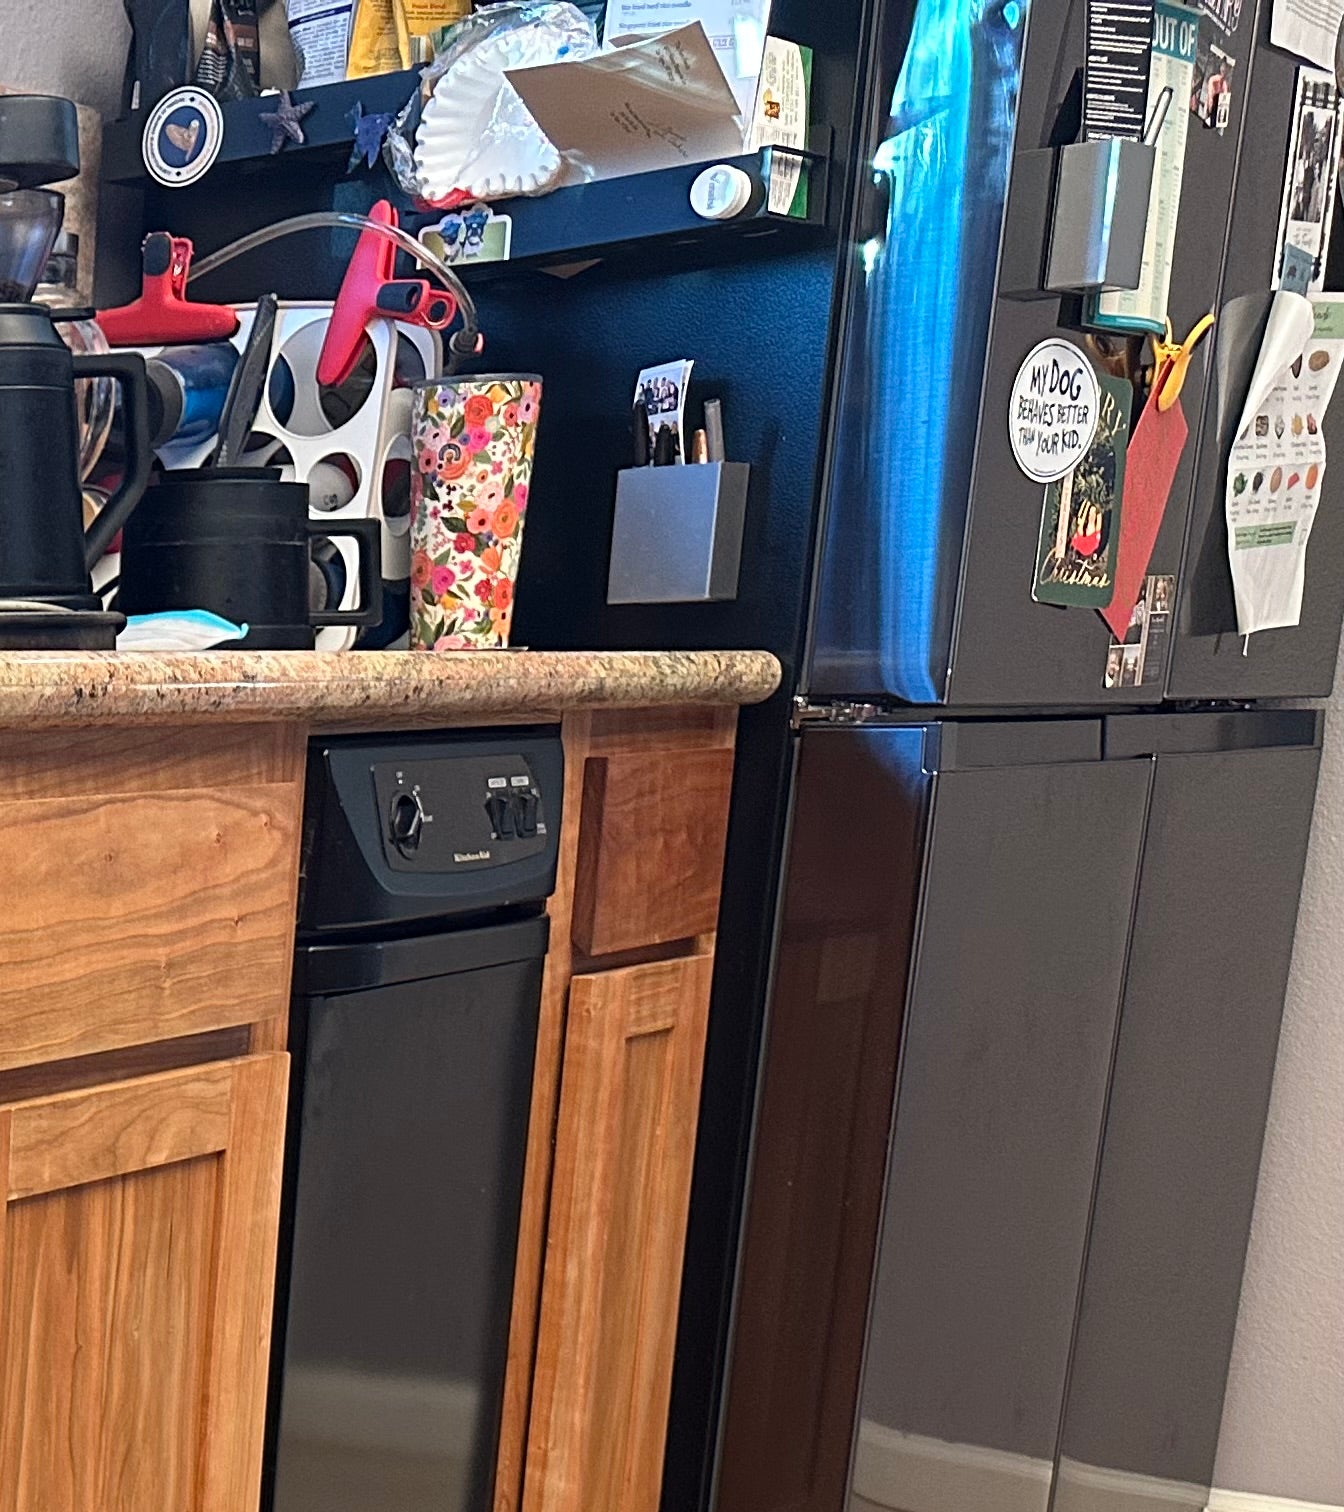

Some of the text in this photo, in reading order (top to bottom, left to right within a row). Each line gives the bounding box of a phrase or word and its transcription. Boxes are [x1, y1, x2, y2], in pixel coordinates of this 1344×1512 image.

[1180, 21, 1196, 56] OF
[1030, 358, 1084, 401] MY DOG
[1017, 395, 1055, 427] BEHAVES
[1057, 403, 1089, 425] BETTER
[1018, 427, 1082, 456] THAN YOUR KID.
[1040, 546, 1111, 588] Christmas
